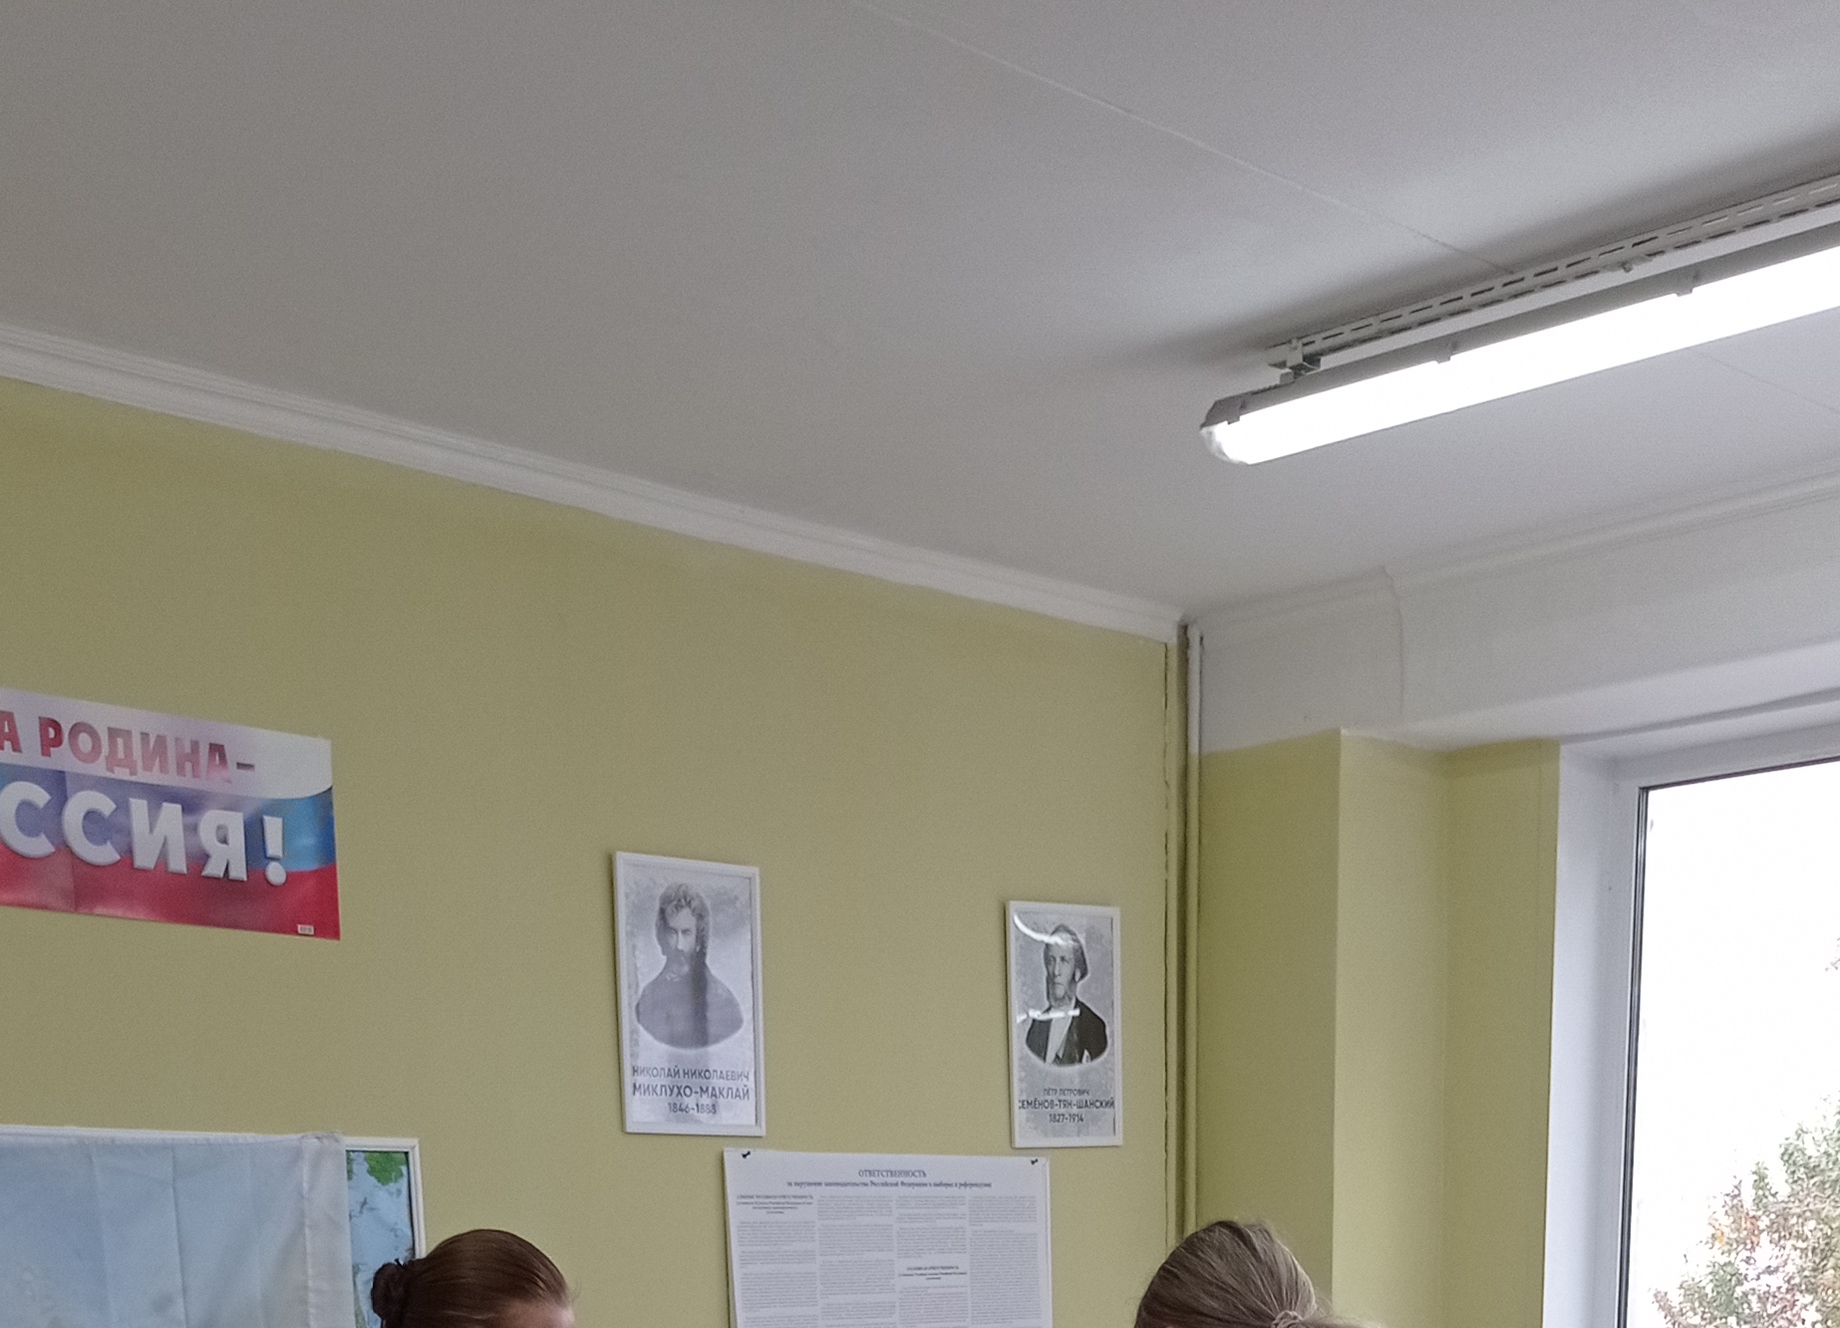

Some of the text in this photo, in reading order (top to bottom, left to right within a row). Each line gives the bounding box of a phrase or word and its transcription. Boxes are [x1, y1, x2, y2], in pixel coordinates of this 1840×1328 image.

[632, 1064, 750, 1081] НИКОЛАЙ НИКОЛАЕВИЧ
[632, 1082, 751, 1100] МИКЛУХО-МАКЛАЙ
[858, 1169, 927, 1179] ОТВЕТСТВЕННОСТЬ
